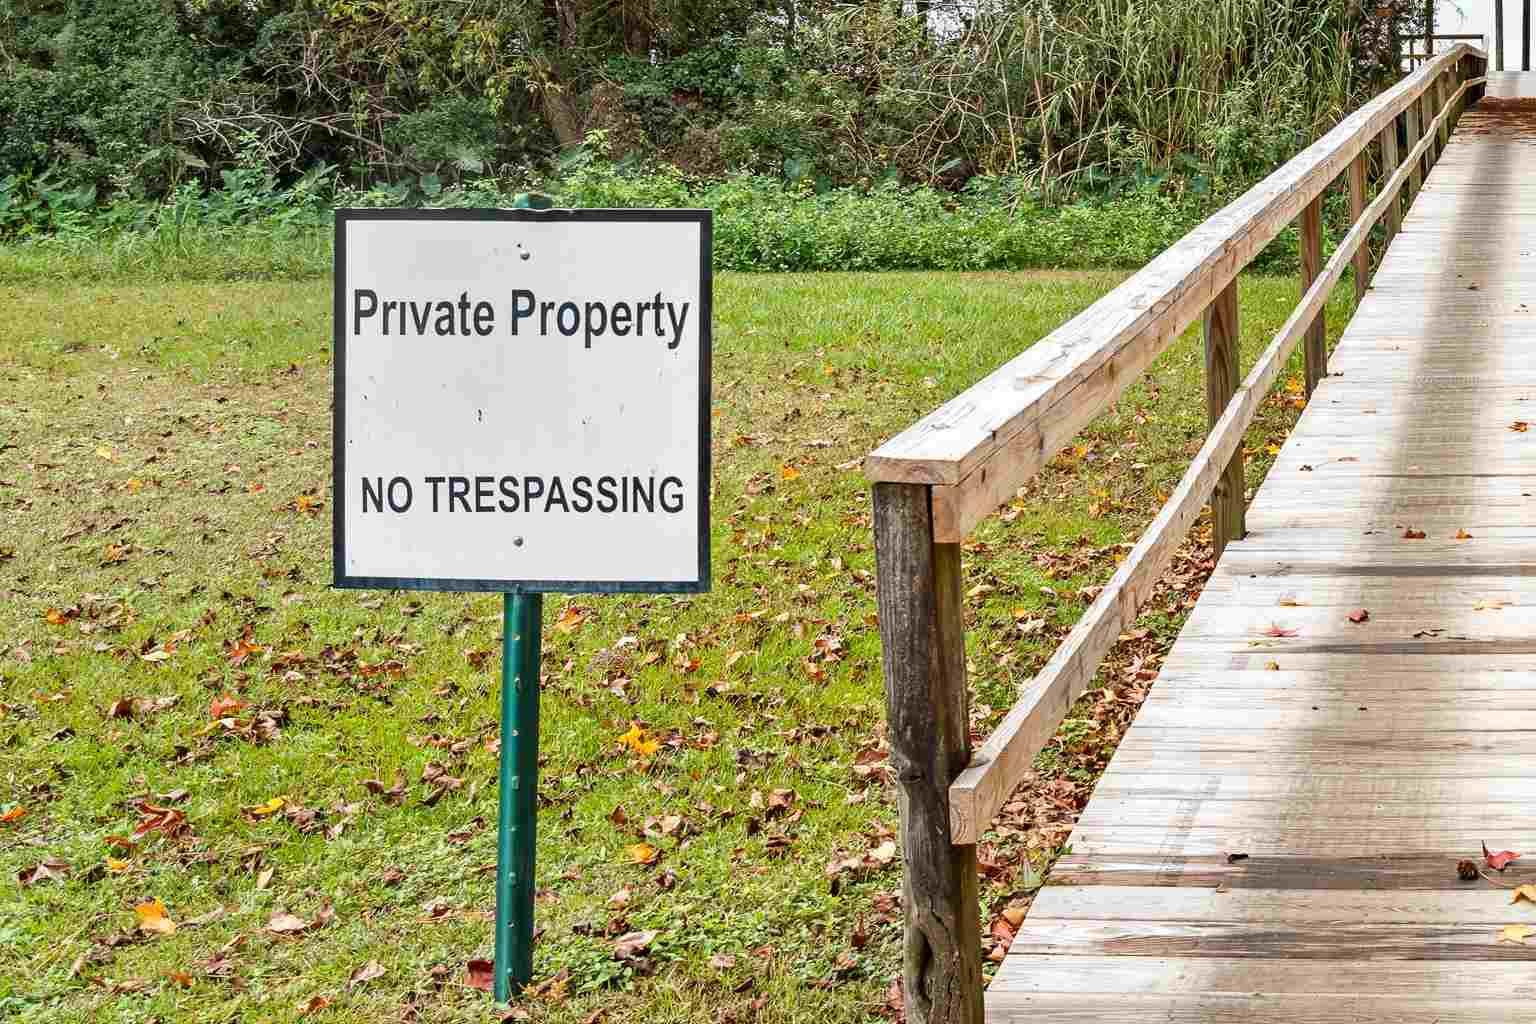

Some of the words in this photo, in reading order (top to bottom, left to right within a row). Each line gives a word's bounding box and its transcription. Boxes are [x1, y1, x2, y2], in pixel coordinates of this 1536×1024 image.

[353, 288, 496, 337] Private
[511, 289, 690, 349] Property
[361, 476, 414, 513] NO
[424, 476, 685, 514] TRESPASSING
